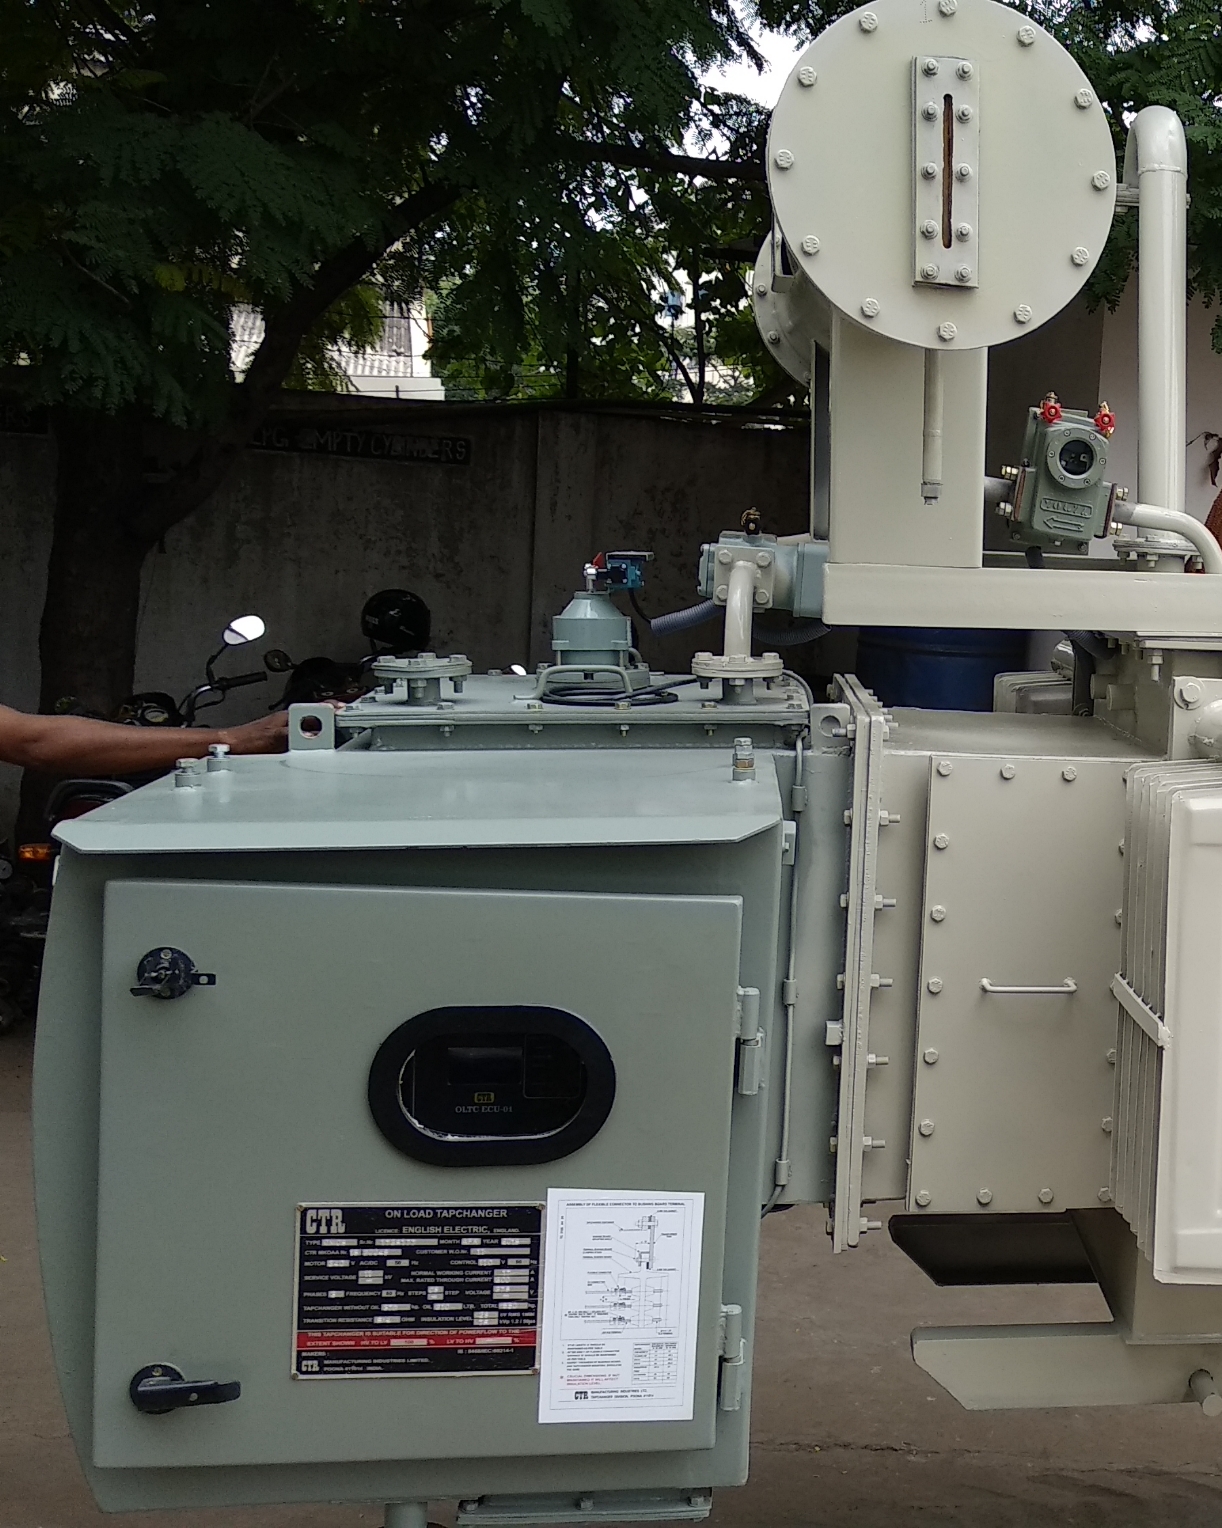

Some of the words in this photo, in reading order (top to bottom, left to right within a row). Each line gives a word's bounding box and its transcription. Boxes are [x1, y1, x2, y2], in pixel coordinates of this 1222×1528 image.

[455, 1105, 480, 1114] OLTC
[481, 1105, 514, 1113] ECU-01
[385, 1209, 401, 1219] ON
[403, 1209, 434, 1218] LOAD
[436, 1209, 508, 1218] TAPCHANGER
[306, 1209, 346, 1234] CTR
[402, 1226, 442, 1234] ENGLISH
[443, 1225, 491, 1234] ELECTRIC,
[301, 1360, 320, 1372] CTR
